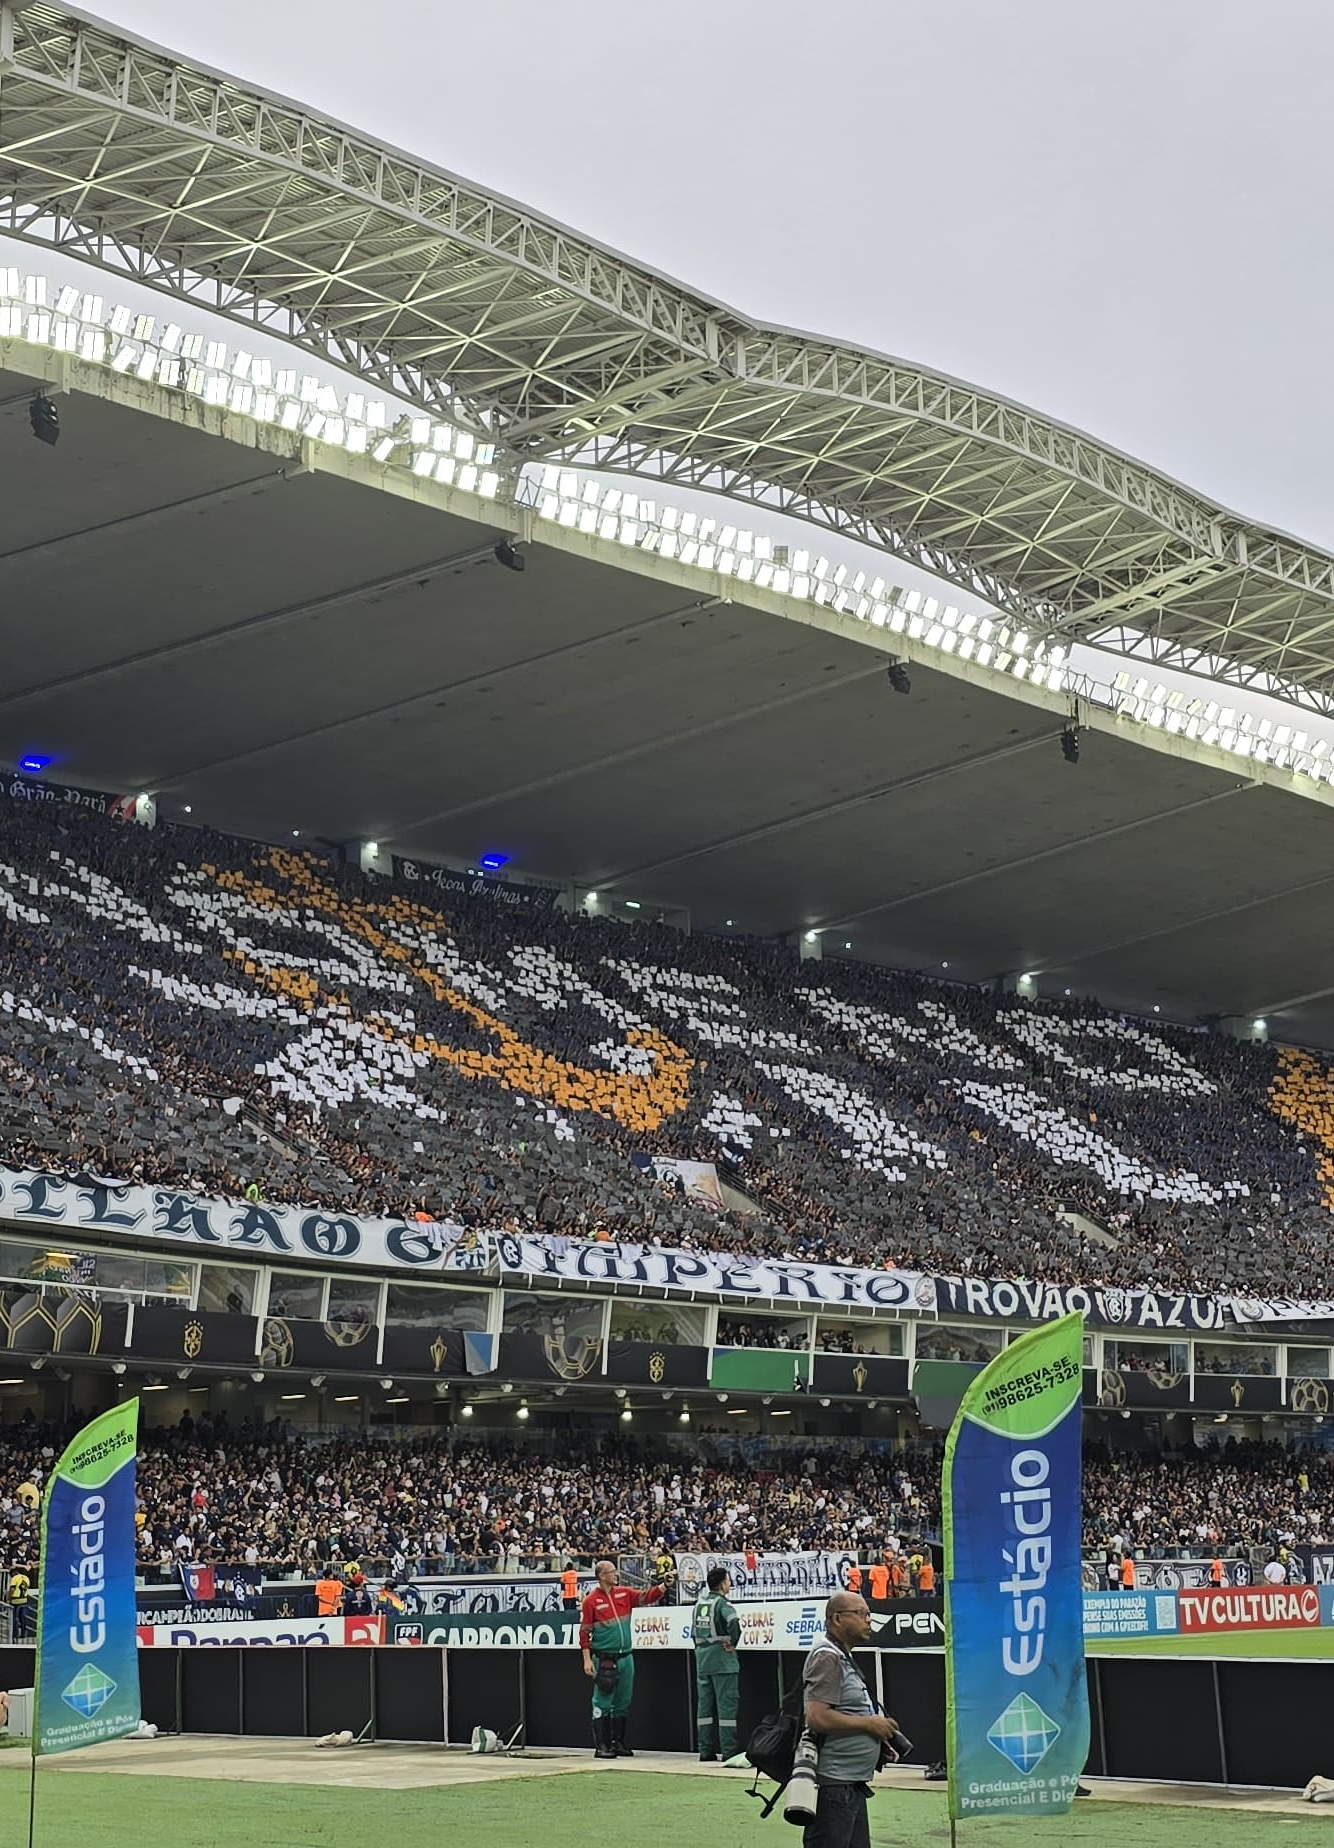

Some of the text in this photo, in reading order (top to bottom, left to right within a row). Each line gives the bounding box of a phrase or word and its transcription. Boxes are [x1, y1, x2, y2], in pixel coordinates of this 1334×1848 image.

[984, 1356, 1070, 1402] INSCREVA-SE
[72, 1429, 126, 1465] INSCREVA-SE
[70, 1495, 106, 1653] Estácio
[999, 1449, 1052, 1676] Estácio
[740, 1612, 775, 1628] SEBRAE
[1211, 1593, 1301, 1624] CULTURA
[399, 1627, 418, 1637] FPF
[634, 1616, 671, 1633] SEBRAE
[895, 1612, 946, 1635] PEN
[46, 1718, 104, 1738] Graduação
[969, 1773, 1080, 1796] Graduação e Pó
[961, 1791, 1036, 1809] Presencial
[1039, 1791, 1049, 1804] E
